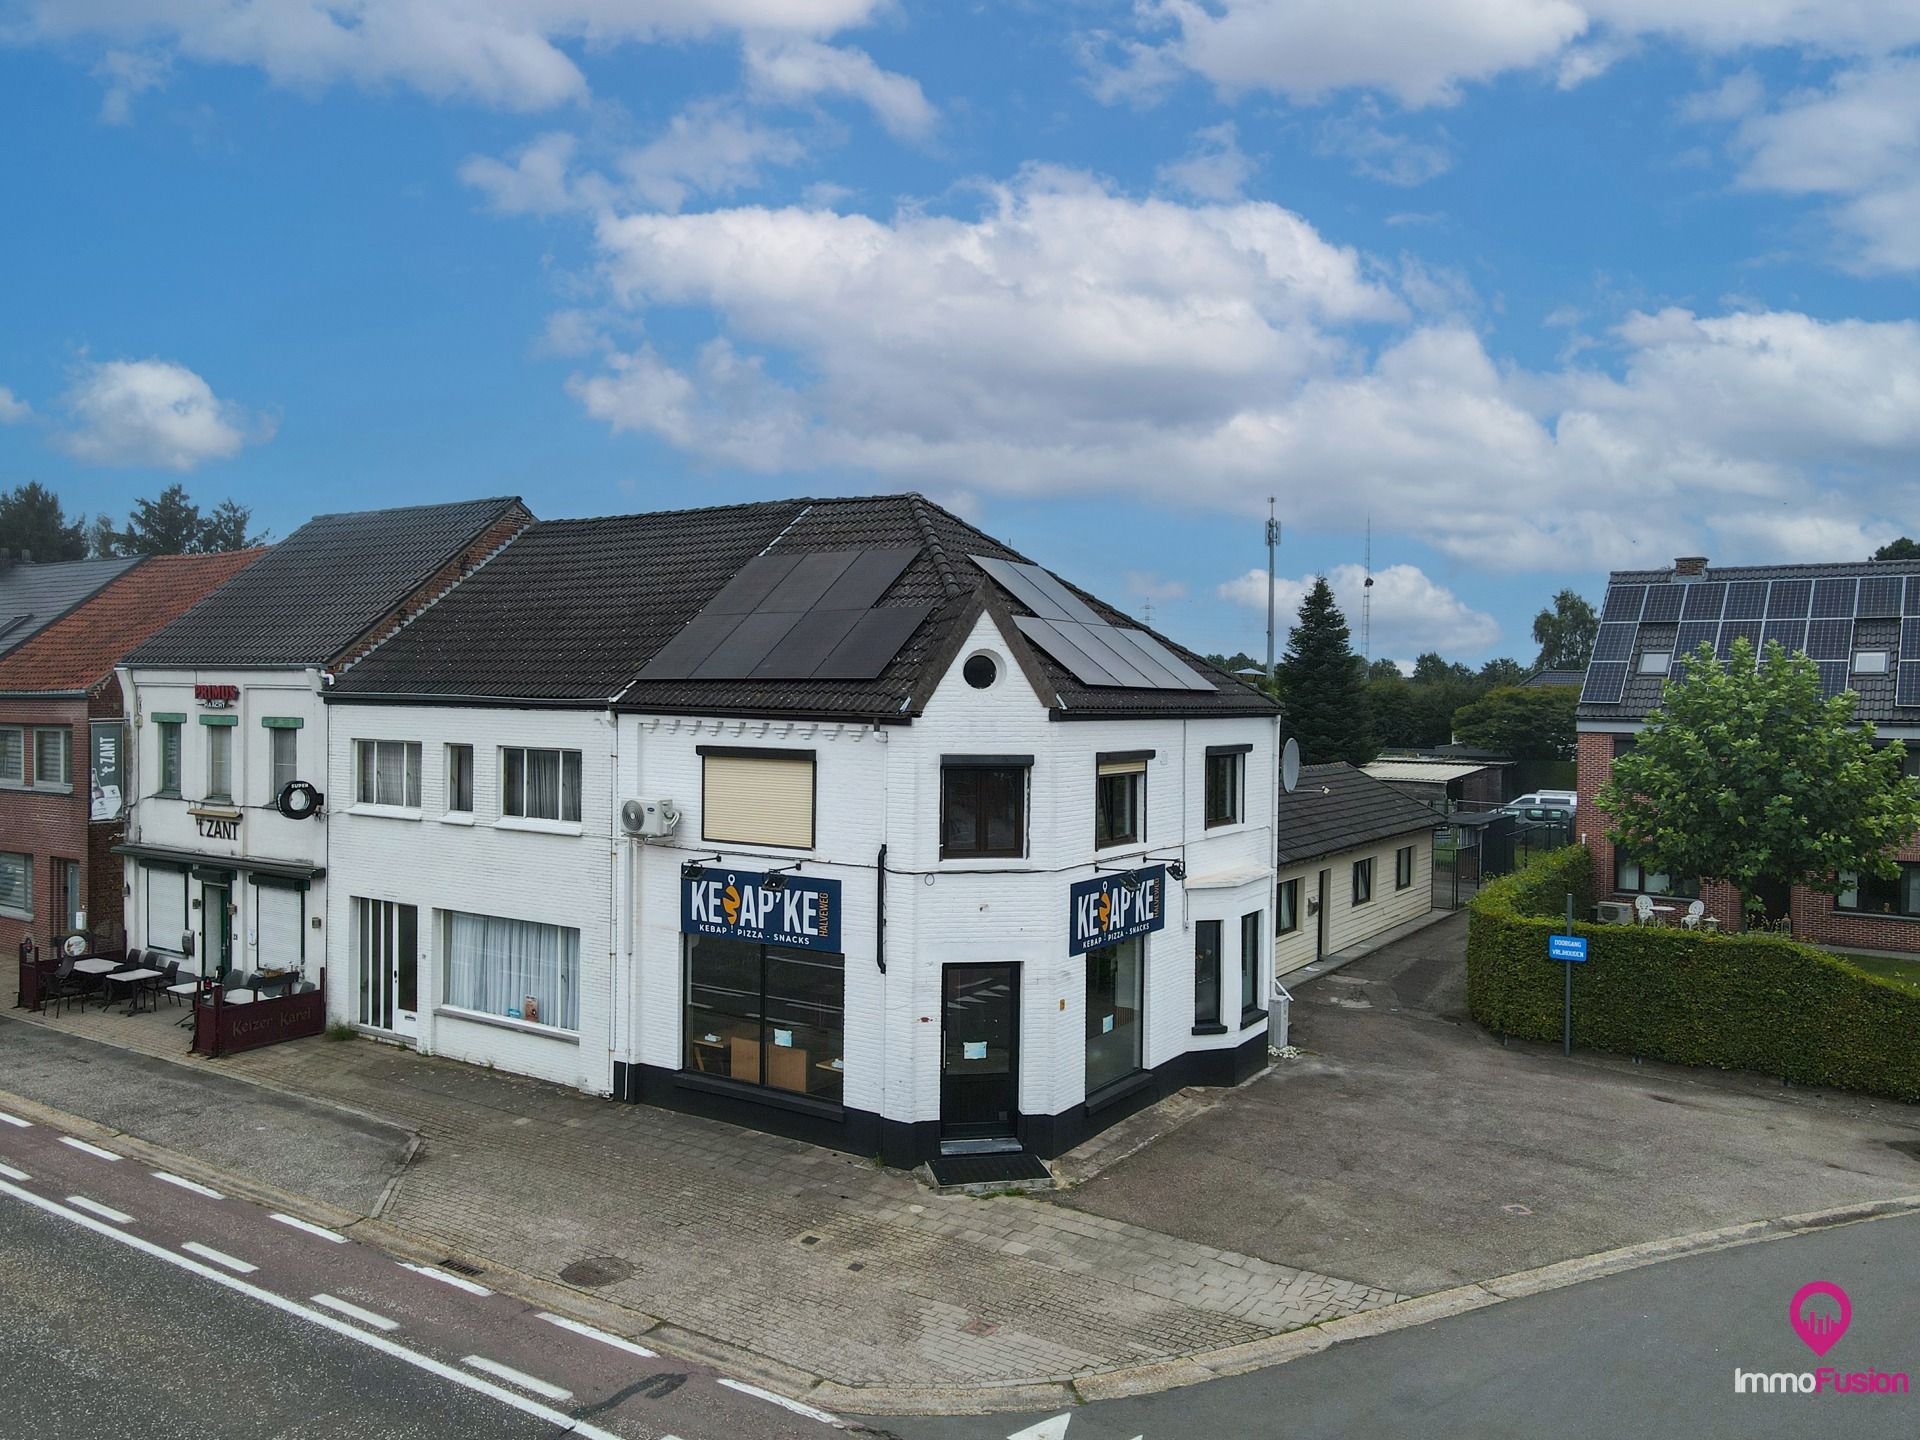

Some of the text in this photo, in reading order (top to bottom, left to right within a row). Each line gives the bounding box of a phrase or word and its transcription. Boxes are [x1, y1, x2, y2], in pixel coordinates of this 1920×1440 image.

[195, 685, 238, 700] PRIMUS
[100, 737, 115, 764] ZANT
[206, 819, 241, 841] ZANT
[818, 892, 829, 937] HALVEWEG
[699, 923, 810, 945] KEBAP PIZZA SNACKS
[1082, 922, 1150, 949] KEBAP PIZZA SNACKS
[1554, 939, 1582, 948] DOORGANG
[232, 1007, 312, 1038] Keizer Karel
